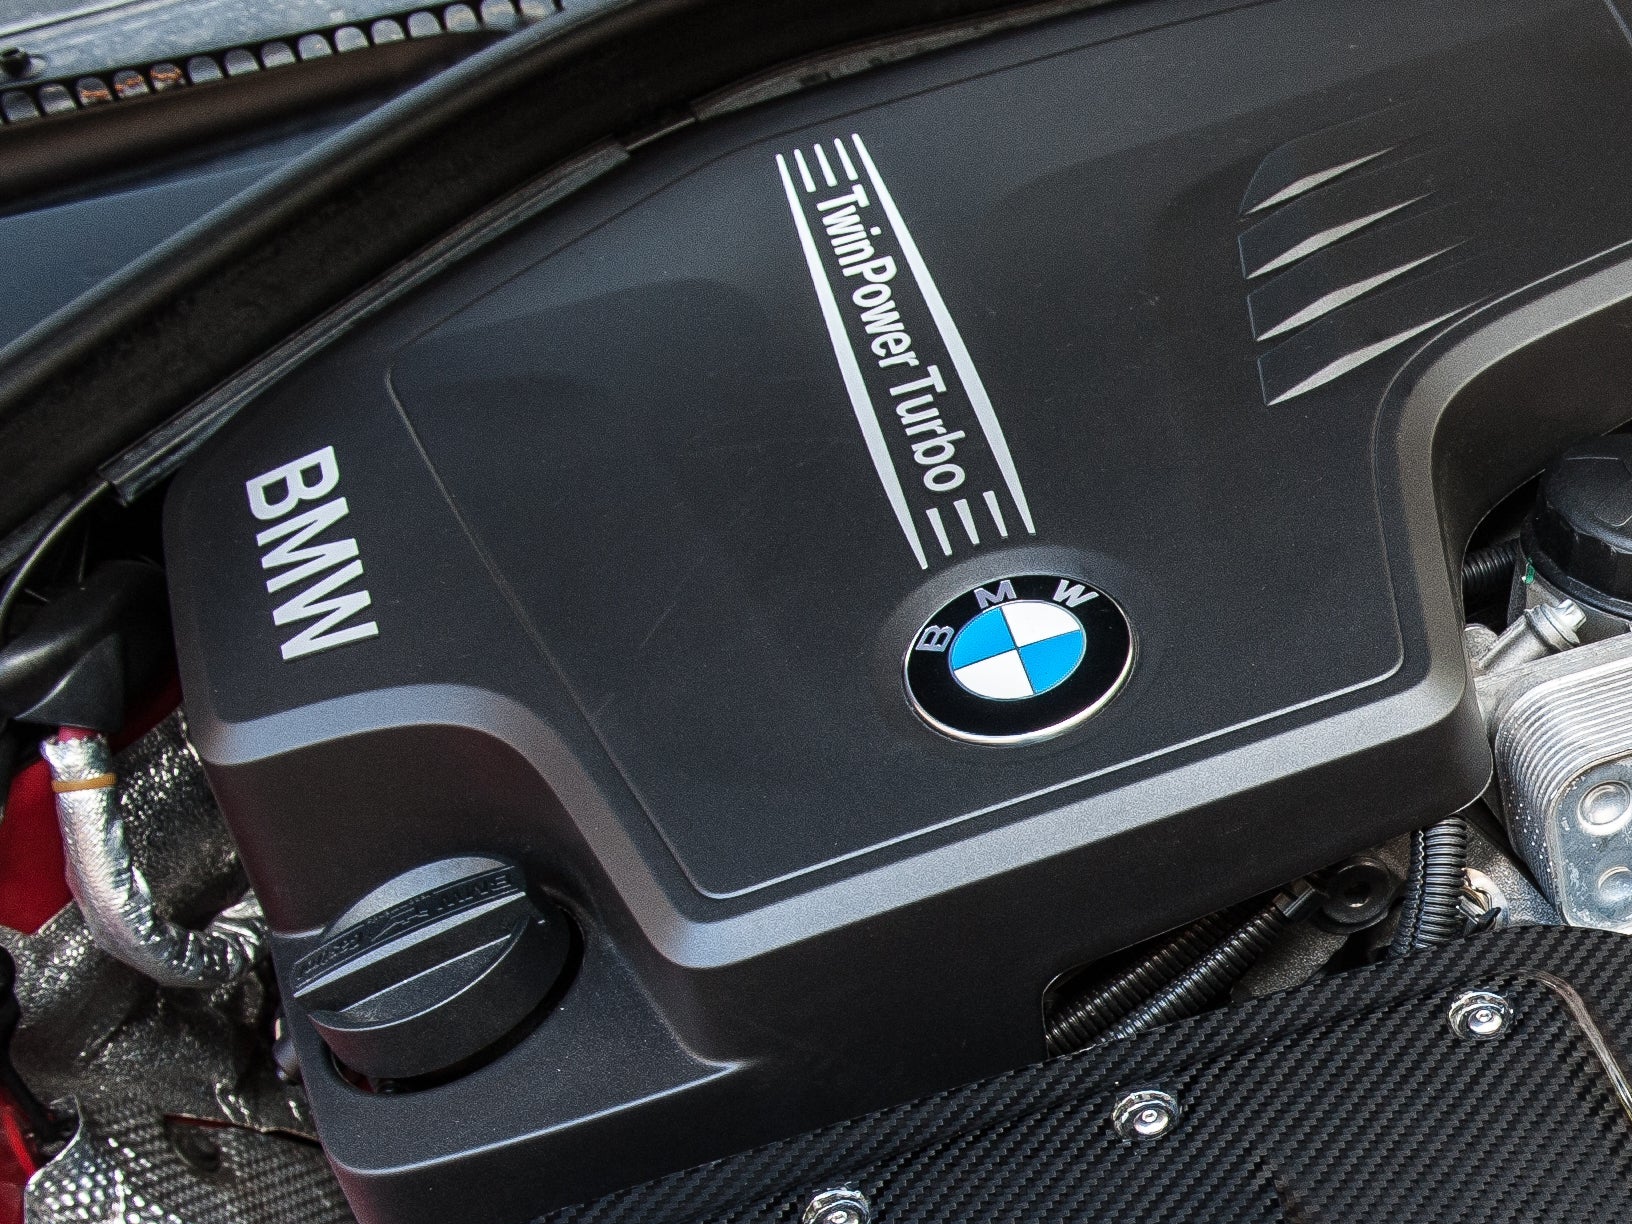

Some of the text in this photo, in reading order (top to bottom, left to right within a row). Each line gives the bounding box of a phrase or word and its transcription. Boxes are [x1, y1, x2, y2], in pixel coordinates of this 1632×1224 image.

[816, 183, 966, 494] TwinPower Turbo
[246, 445, 379, 660] BMW
[915, 579, 1099, 654] BMW
